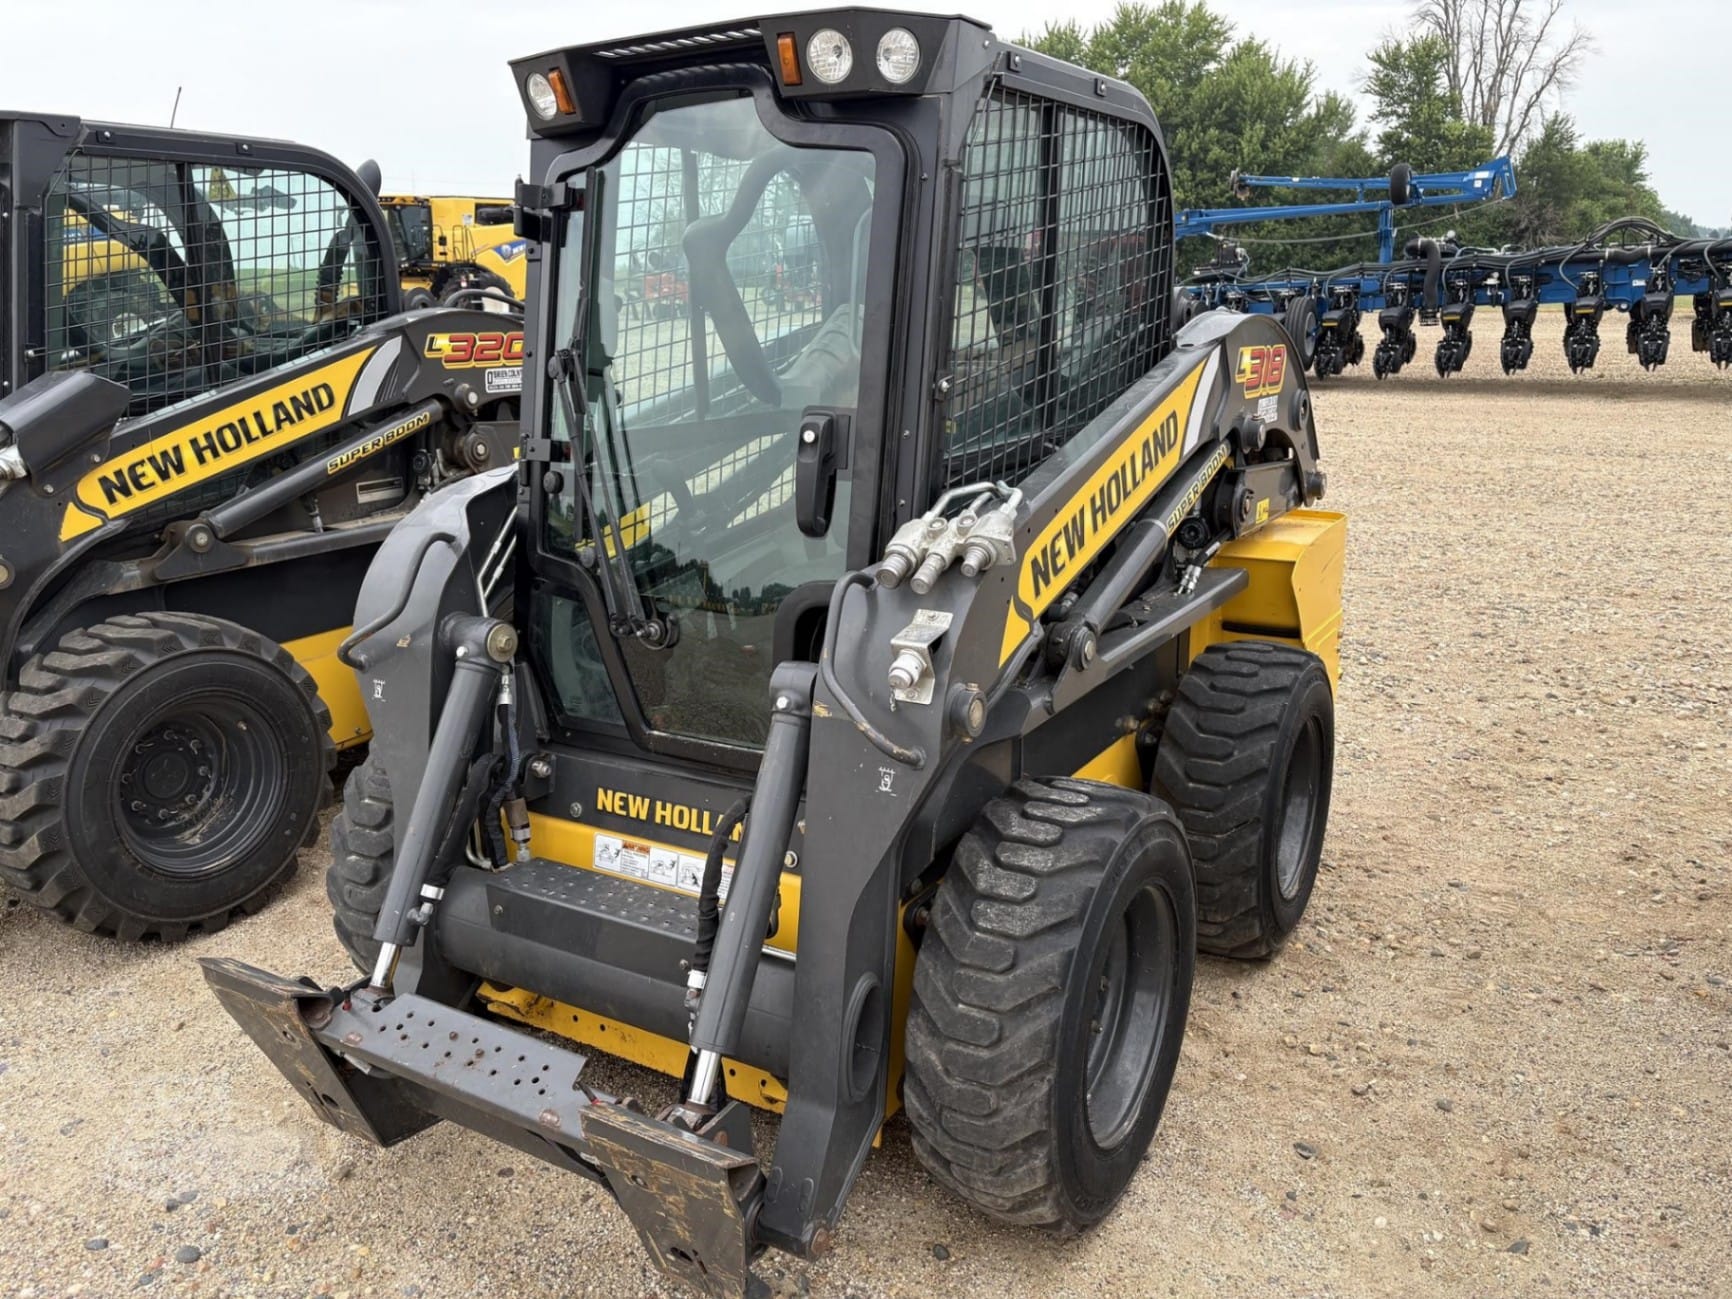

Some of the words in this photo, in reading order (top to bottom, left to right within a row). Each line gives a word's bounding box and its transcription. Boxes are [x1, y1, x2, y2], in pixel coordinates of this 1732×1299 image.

[424, 332, 524, 369] L320
[1236, 345, 1287, 398] L318
[97, 445, 186, 505] NEW
[189, 382, 336, 465] HOLLAND
[328, 436, 383, 474] SUPER
[384, 412, 430, 445] BOOM
[1030, 504, 1085, 599] NEW
[1090, 410, 1178, 536] HOLLAND
[1167, 481, 1200, 538] SUPER
[1199, 444, 1228, 491] BOOM
[597, 787, 650, 821] NEW
[655, 800, 743, 842] HOLL
